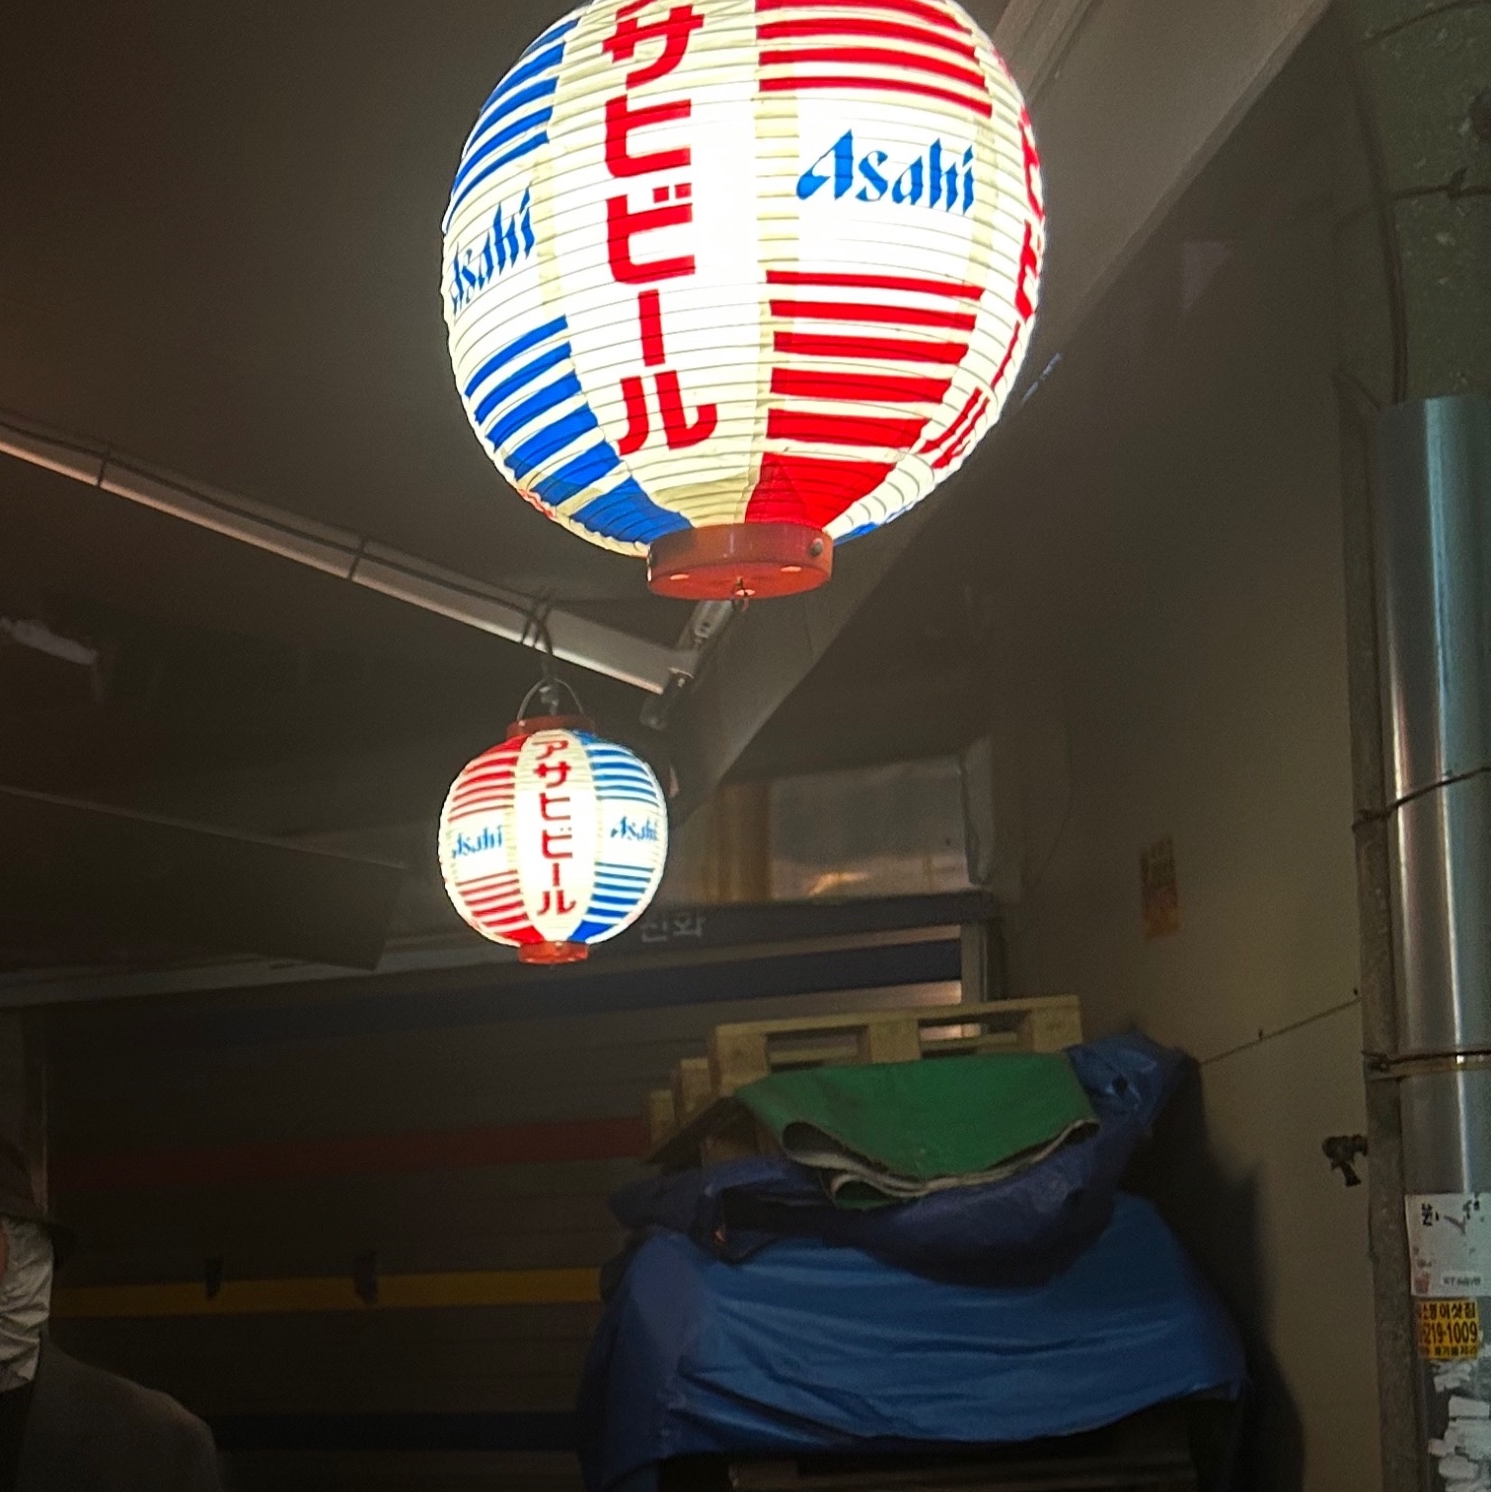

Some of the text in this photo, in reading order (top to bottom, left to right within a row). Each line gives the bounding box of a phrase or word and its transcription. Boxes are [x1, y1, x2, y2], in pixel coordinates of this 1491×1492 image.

[600, 0, 720, 456] サヒビール
[795, 129, 976, 215] Asahi
[531, 739, 577, 917] アサヒビール
